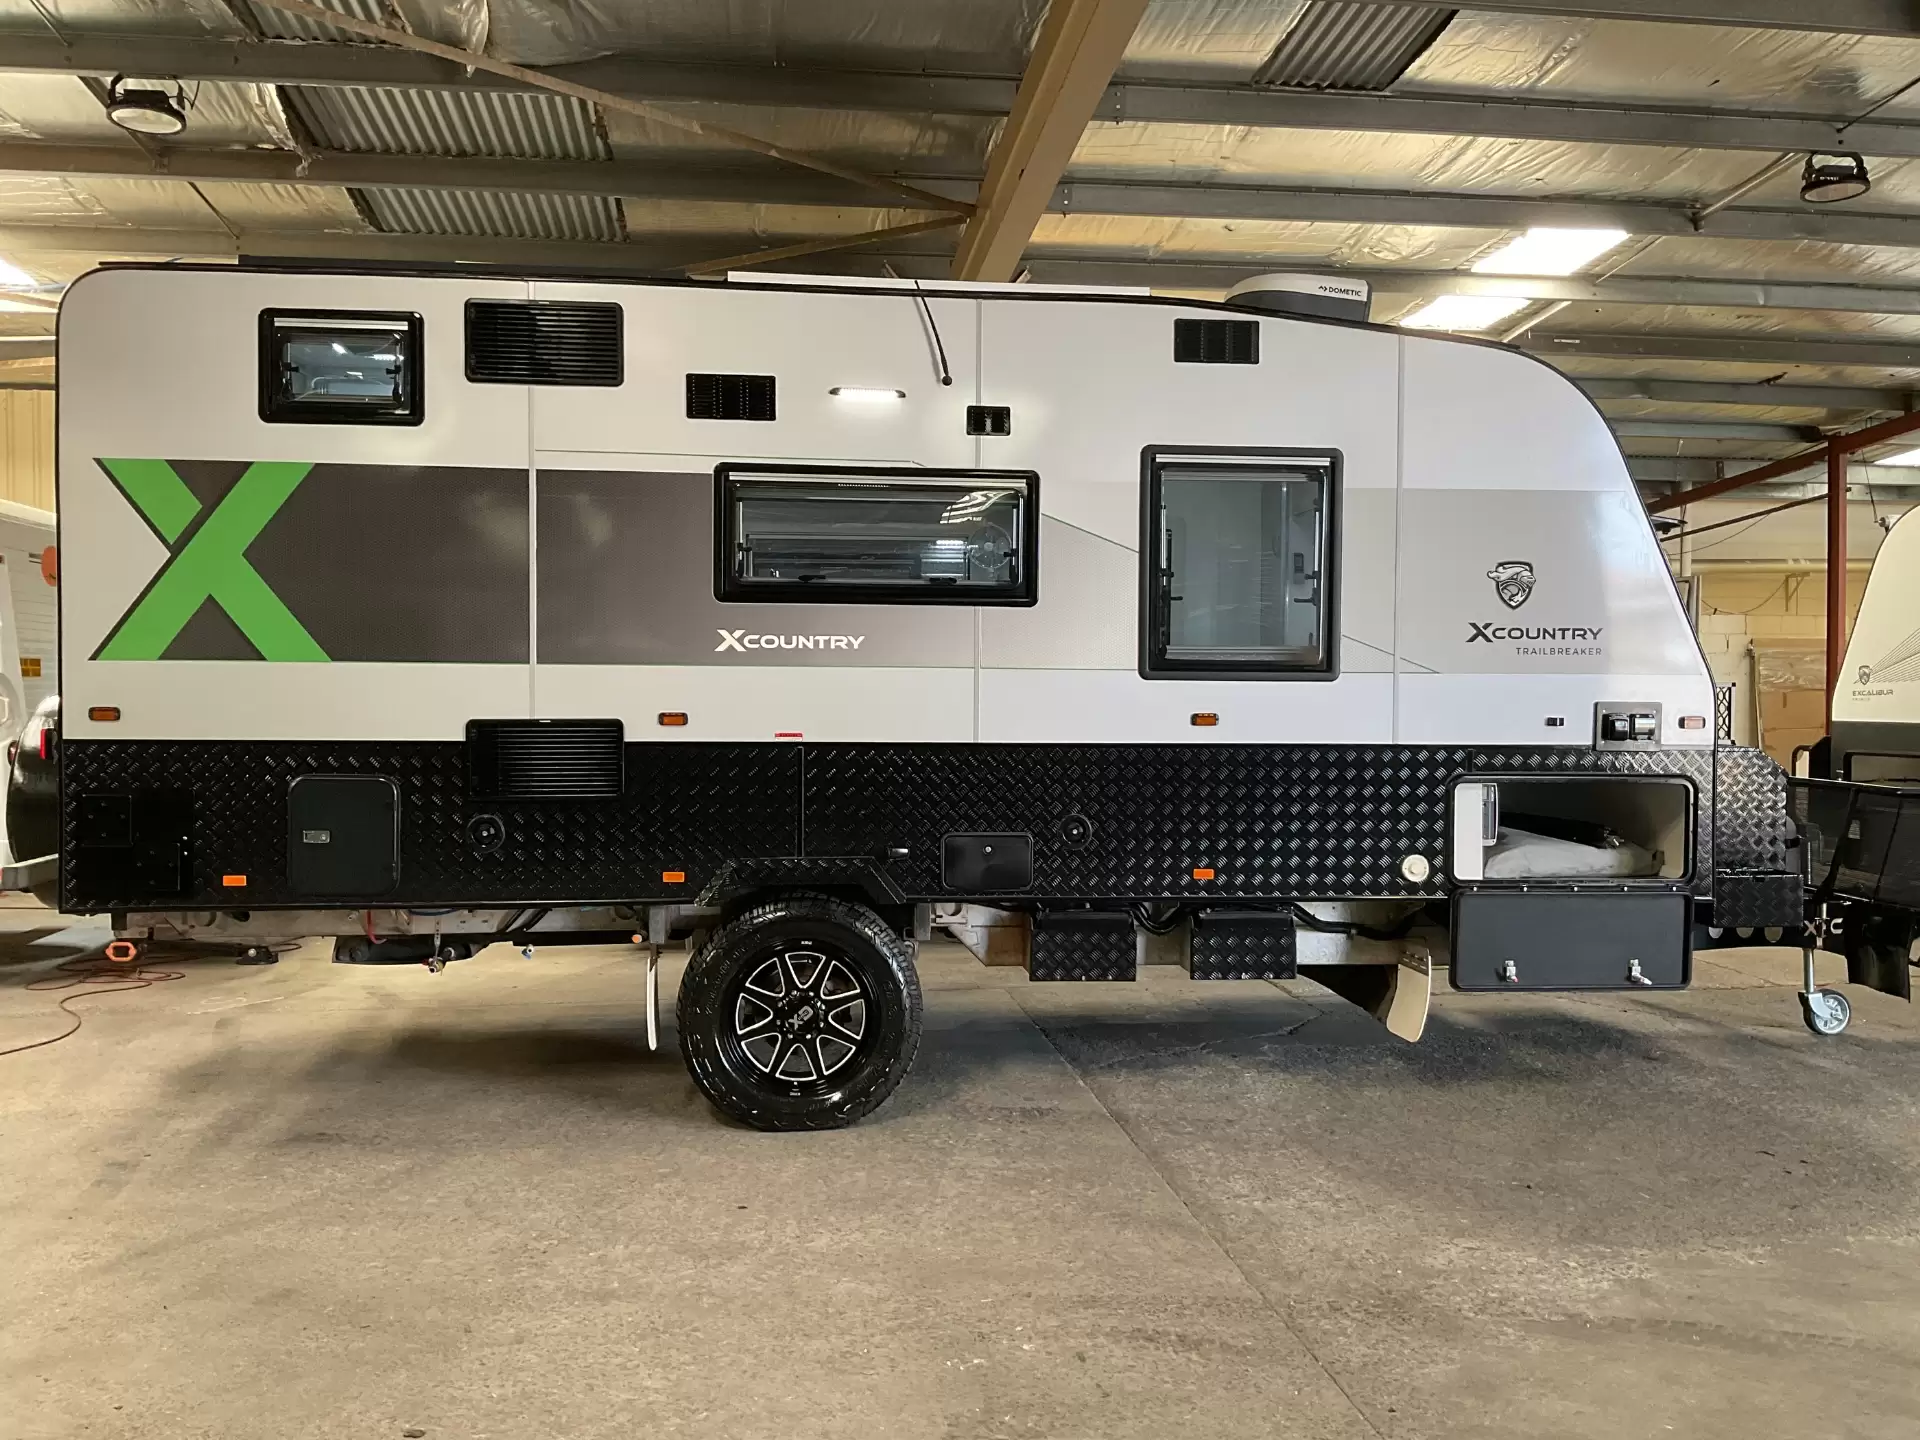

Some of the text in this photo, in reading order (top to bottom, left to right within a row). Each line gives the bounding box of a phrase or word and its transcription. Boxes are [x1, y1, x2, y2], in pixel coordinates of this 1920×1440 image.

[1328, 286, 1362, 297] DOMETIC
[1465, 622, 1604, 643] XCOUNTRY
[714, 629, 866, 652] XCOUNTRY
[1515, 647, 1602, 656] TRAILBREAKER
[1852, 689, 1894, 697] EXCALIBUR
